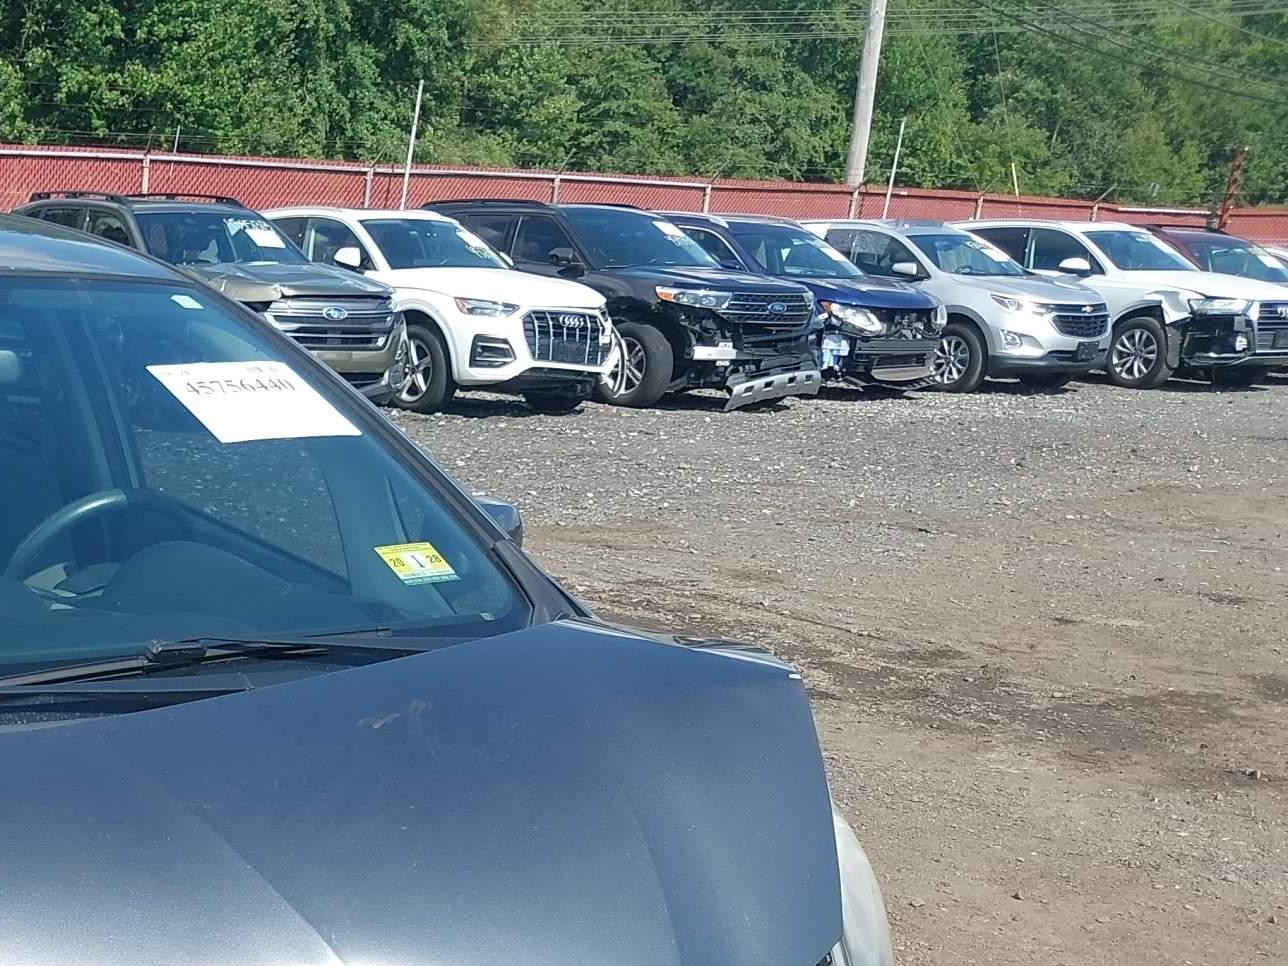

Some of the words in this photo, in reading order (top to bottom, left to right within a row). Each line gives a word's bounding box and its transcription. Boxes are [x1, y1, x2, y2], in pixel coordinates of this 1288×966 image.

[186, 378, 295, 395] 45756440
[389, 557, 406, 568] 20
[425, 554, 443, 564] 28
